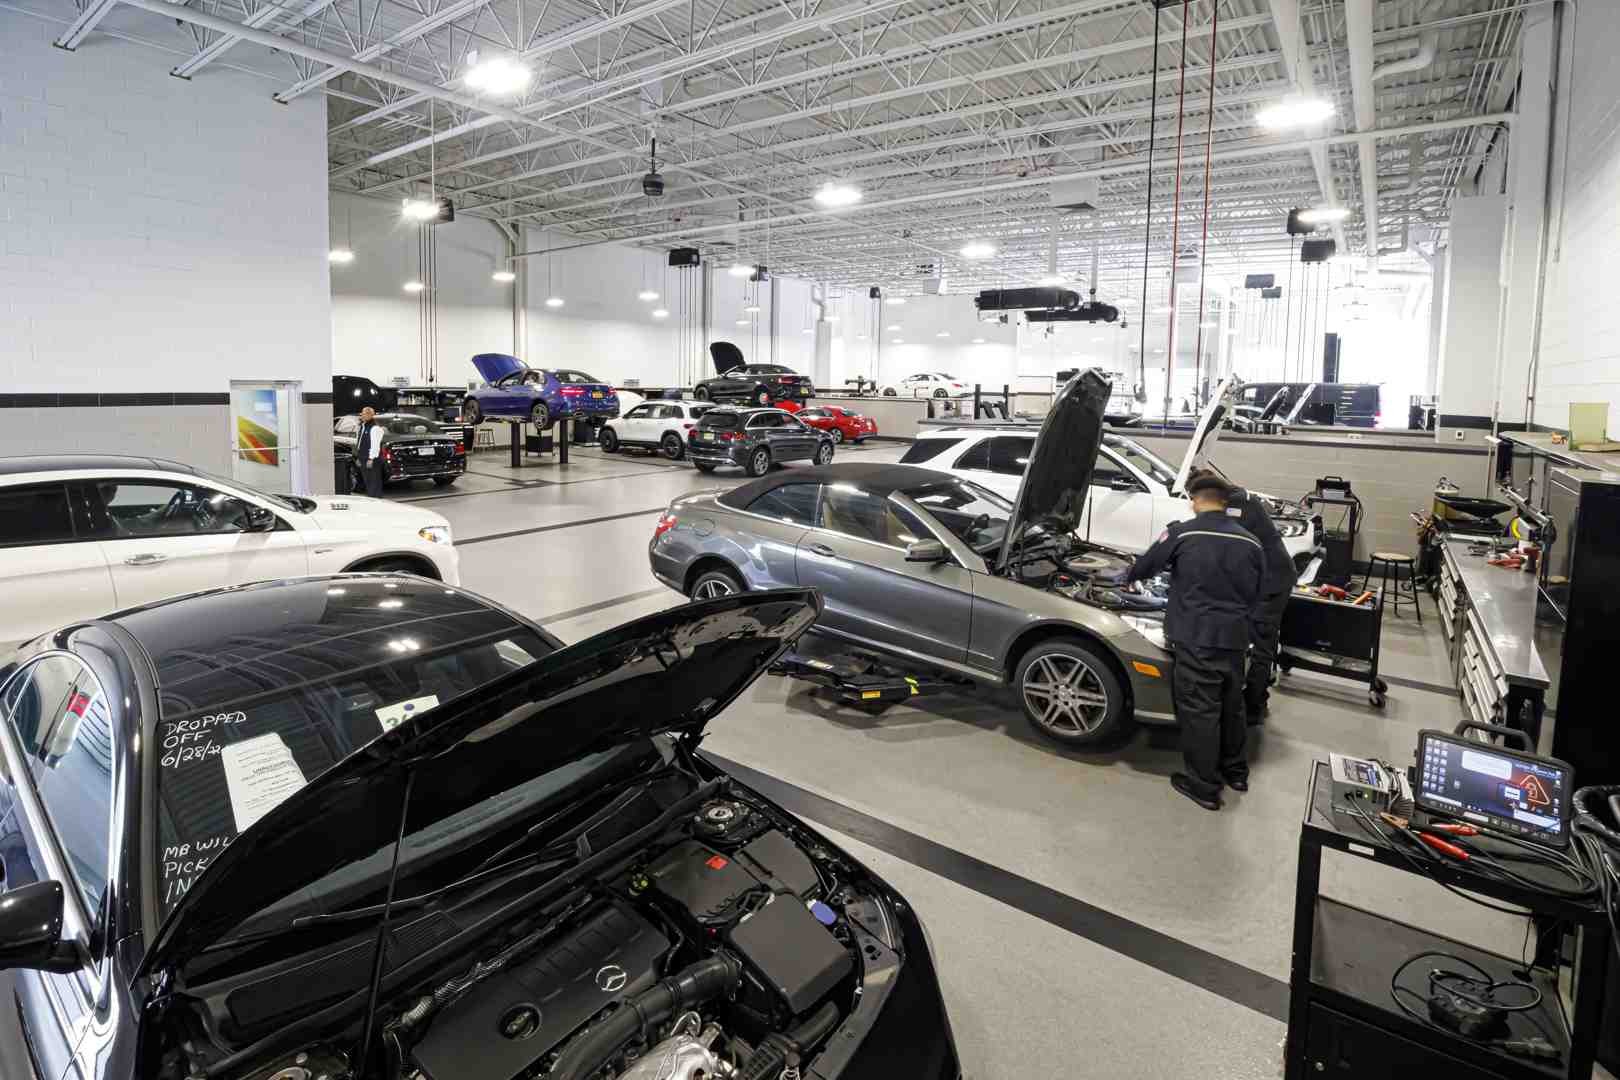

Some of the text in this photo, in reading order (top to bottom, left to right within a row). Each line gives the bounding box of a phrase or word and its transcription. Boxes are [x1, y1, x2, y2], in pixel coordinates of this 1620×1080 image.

[165, 711, 247, 736] DROPPED
[163, 729, 212, 748] OFF
[163, 837, 230, 862] MB WIL
[164, 857, 209, 879] PICK
